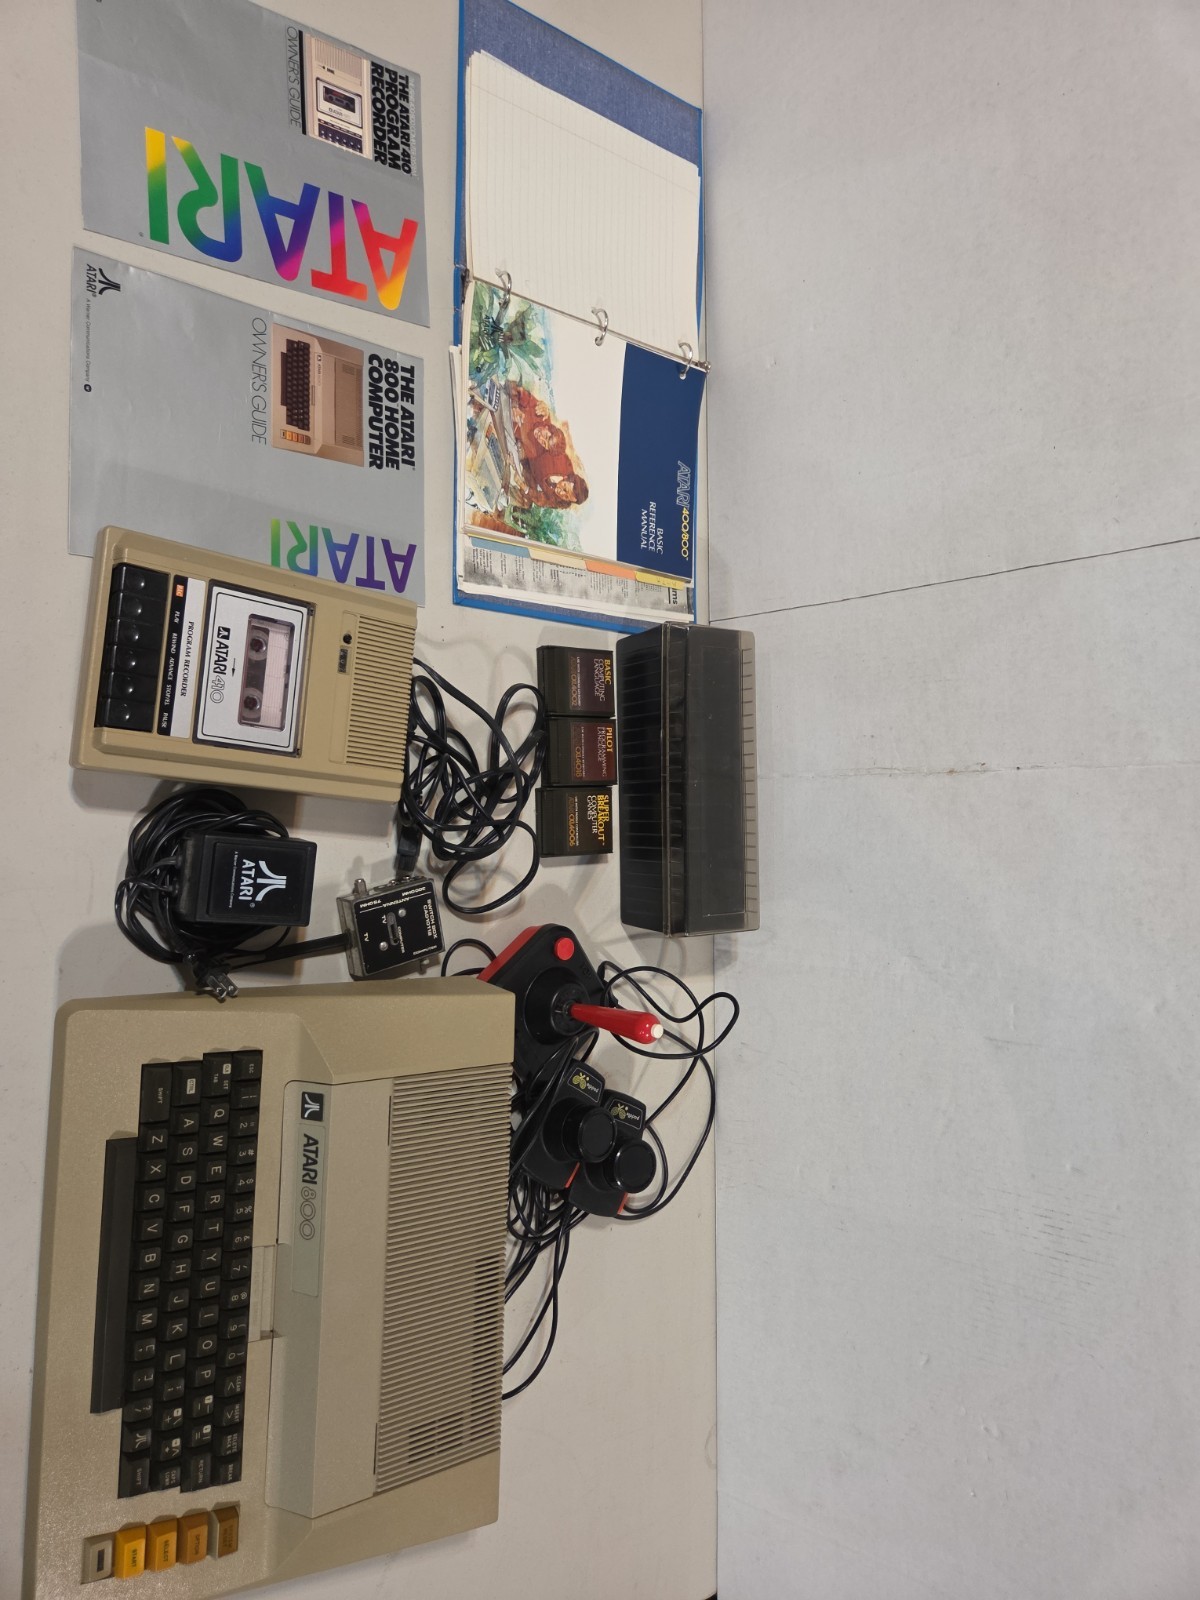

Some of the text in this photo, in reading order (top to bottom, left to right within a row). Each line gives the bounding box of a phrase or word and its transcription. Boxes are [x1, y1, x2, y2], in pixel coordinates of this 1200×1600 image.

[286, 26, 302, 128] OWNER'S GUIDE
[371, 62, 388, 166] RECORDER
[385, 68, 401, 170] PROGRAM
[399, 75, 412, 174] THE ATARI 410
[144, 126, 419, 310] ATARI
[86, 264, 96, 294] ATARI
[251, 318, 267, 446] OWNER'S GUIDE
[368, 354, 383, 470] COMPUTER
[384, 358, 400, 470] 800 HOME
[400, 366, 415, 467] THE ATARI
[676, 461, 691, 557] ATARI 400/800
[640, 508, 648, 550] MANUAL
[648, 501, 657, 552] REFERENCE
[656, 528, 664, 555] BASIC
[270, 519, 417, 593] ATARI
[170, 632, 178, 654] REWIND
[180, 621, 194, 696] PROGRAM RECORDER
[167, 656, 175, 681] ADVANCE
[210, 640, 229, 704] ATARI 410
[604, 660, 612, 684] BASIC
[238, 859, 256, 900] ATARI
[382, 898, 410, 908] ANTENNA
[426, 899, 435, 924] SWITCH
[382, 914, 387, 924] TV
[364, 932, 370, 942] TV
[214, 1108, 224, 1118] Q
[184, 1118, 194, 1128] A
[152, 1135, 162, 1144] Z
[212, 1136, 224, 1146] W
[182, 1146, 193, 1156] S
[150, 1164, 162, 1174] X
[211, 1166, 222, 1174] E
[180, 1176, 192, 1184] D
[299, 1134, 319, 1241] ATARI 800
[148, 1194, 160, 1203] C
[210, 1194, 220, 1204] R
[179, 1205, 190, 1213] F
[147, 1224, 158, 1232] V
[208, 1224, 219, 1232] T
[178, 1234, 188, 1244] G
[145, 1253, 156, 1262] B
[206, 1253, 216, 1261] Y
[176, 1264, 186, 1274] H
[144, 1284, 154, 1293] N
[205, 1282, 216, 1291] U
[173, 1296, 184, 1304] J
[142, 1313, 152, 1324] M
[172, 1324, 183, 1334] K
[230, 1324, 238, 1332] 9
[202, 1340, 212, 1350] O
[170, 1354, 181, 1364] L
[200, 1370, 212, 1378] P
